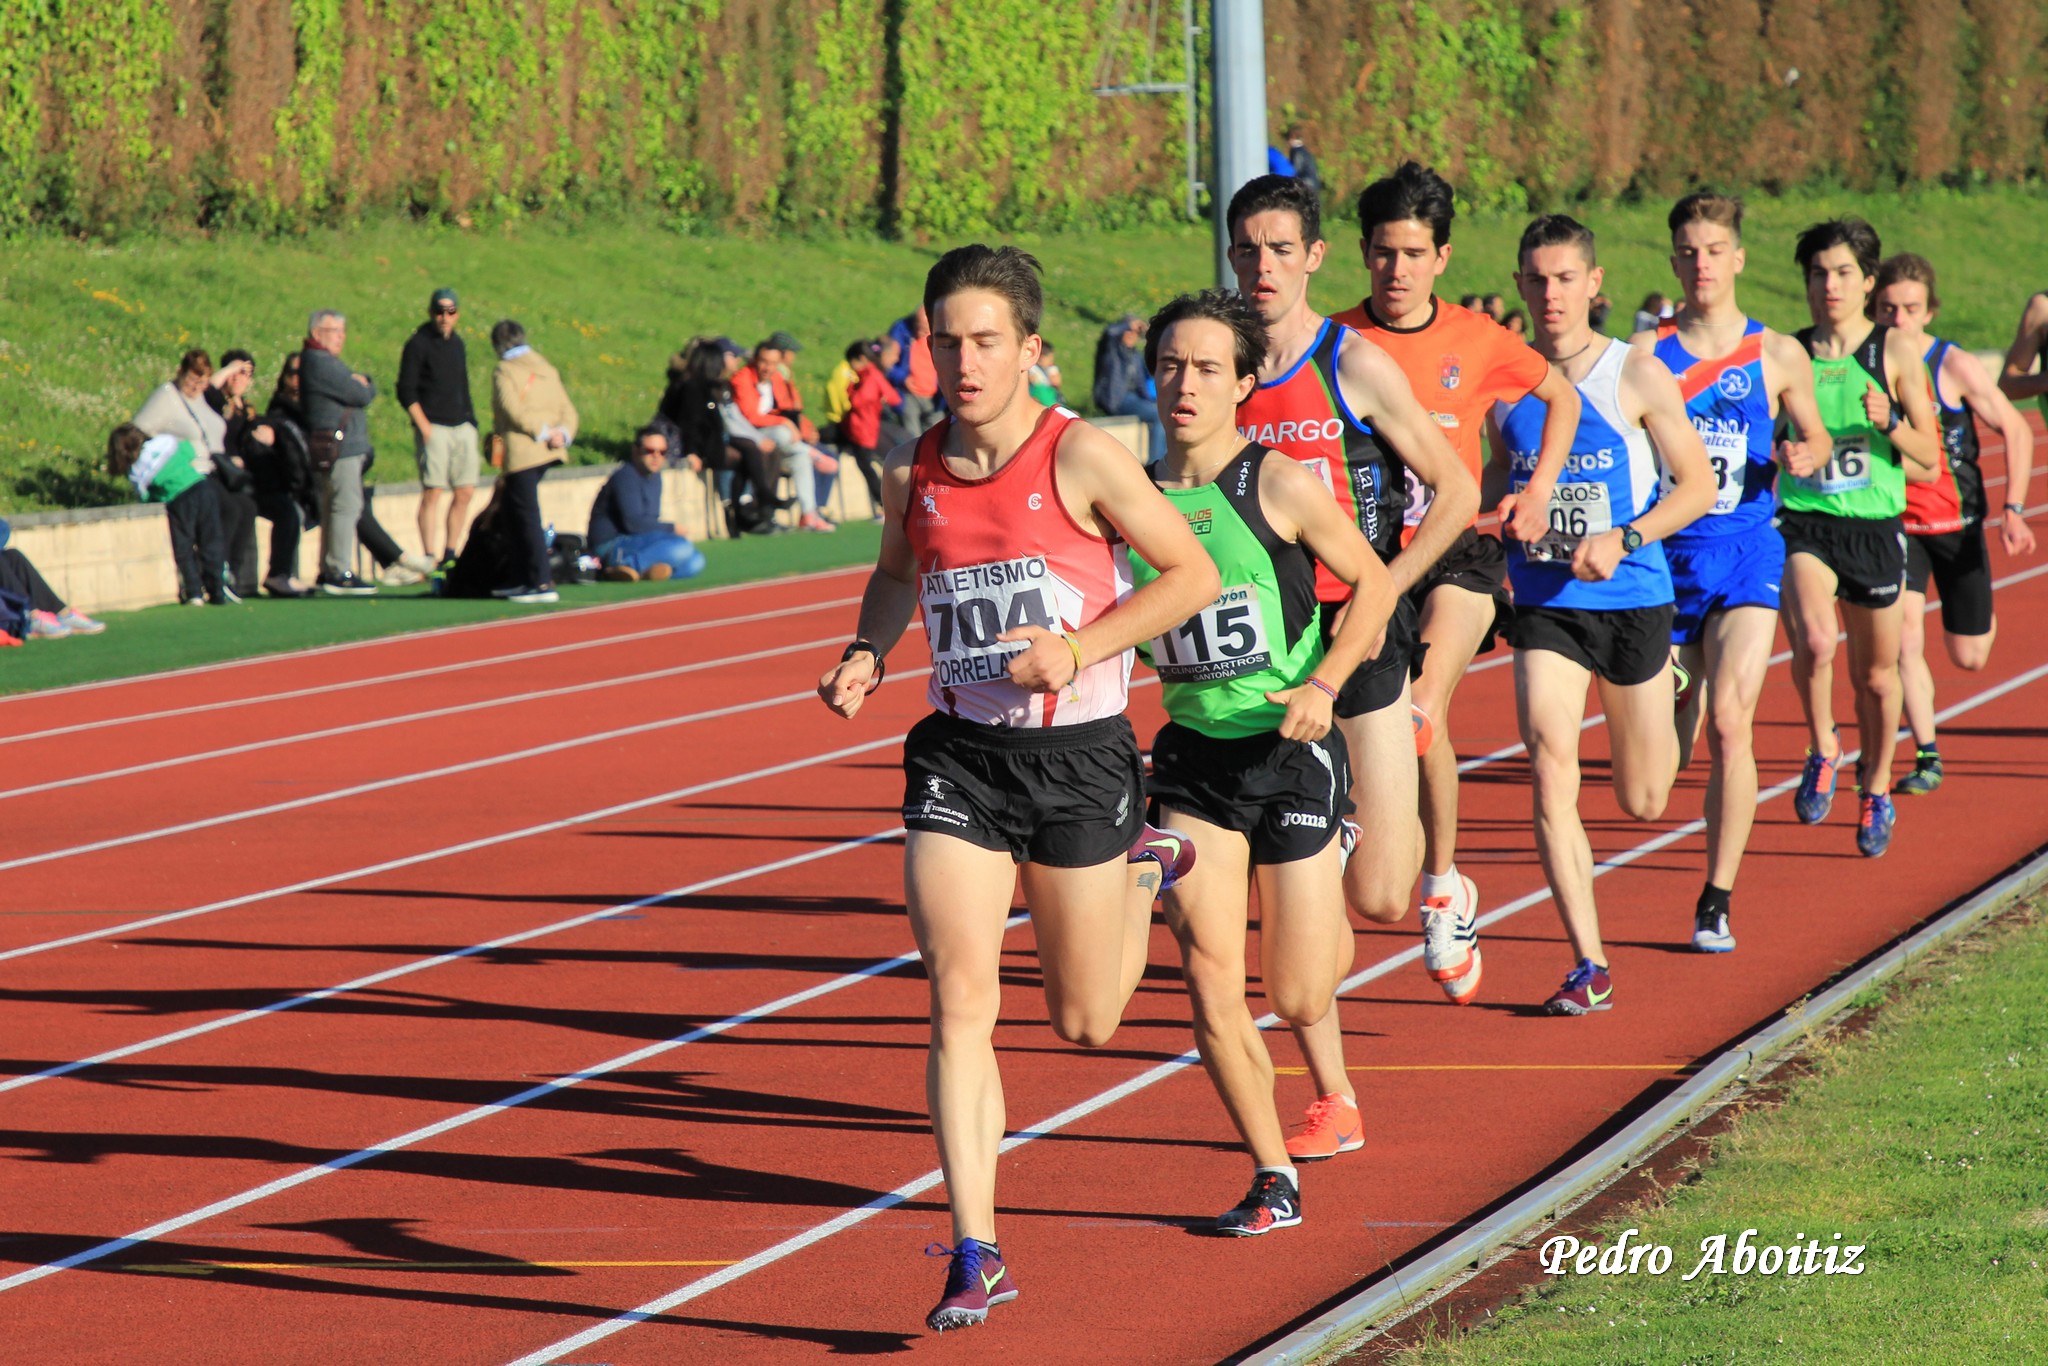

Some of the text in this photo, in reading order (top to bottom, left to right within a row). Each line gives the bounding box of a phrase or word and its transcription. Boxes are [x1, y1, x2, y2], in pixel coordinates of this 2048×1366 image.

[1702, 433, 1740, 448] altec
[1236, 461, 1251, 496] CAYON
[926, 558, 1046, 597] ATLETISMO
[1213, 588, 1248, 607] yón
[930, 587, 1055, 653] 704
[1153, 604, 1257, 665] 115
[1193, 669, 1237, 681] SANTOÑA
[1212, 654, 1265, 671] ARTROS
